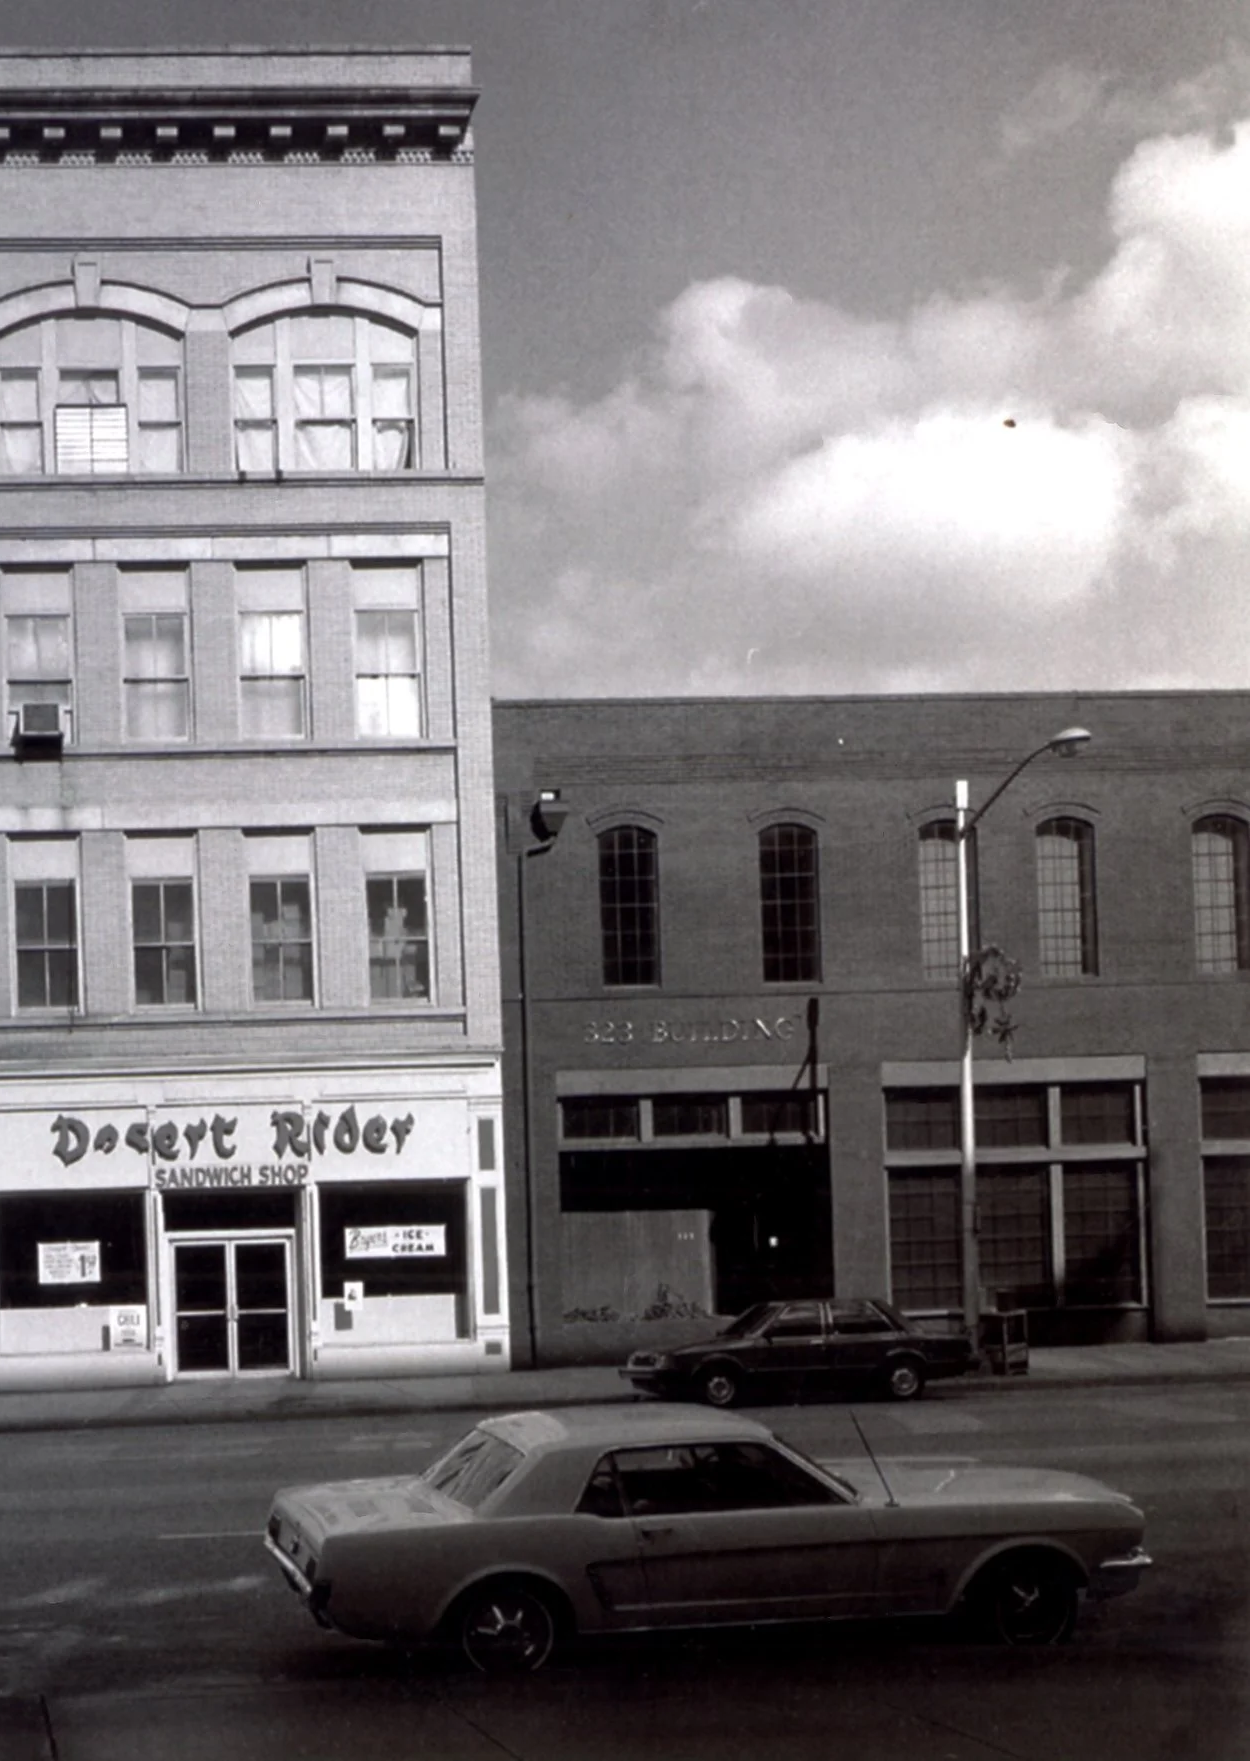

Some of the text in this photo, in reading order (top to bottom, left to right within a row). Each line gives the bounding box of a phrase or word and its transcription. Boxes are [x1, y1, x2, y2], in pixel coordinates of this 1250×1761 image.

[583, 1015, 796, 1046] 323 BUILDING
[50, 1103, 415, 1168] Desert Rider
[155, 1162, 310, 1190] SANDWICH SHOP
[391, 1243, 435, 1254] CREAM
[402, 1229, 423, 1241] ICE
